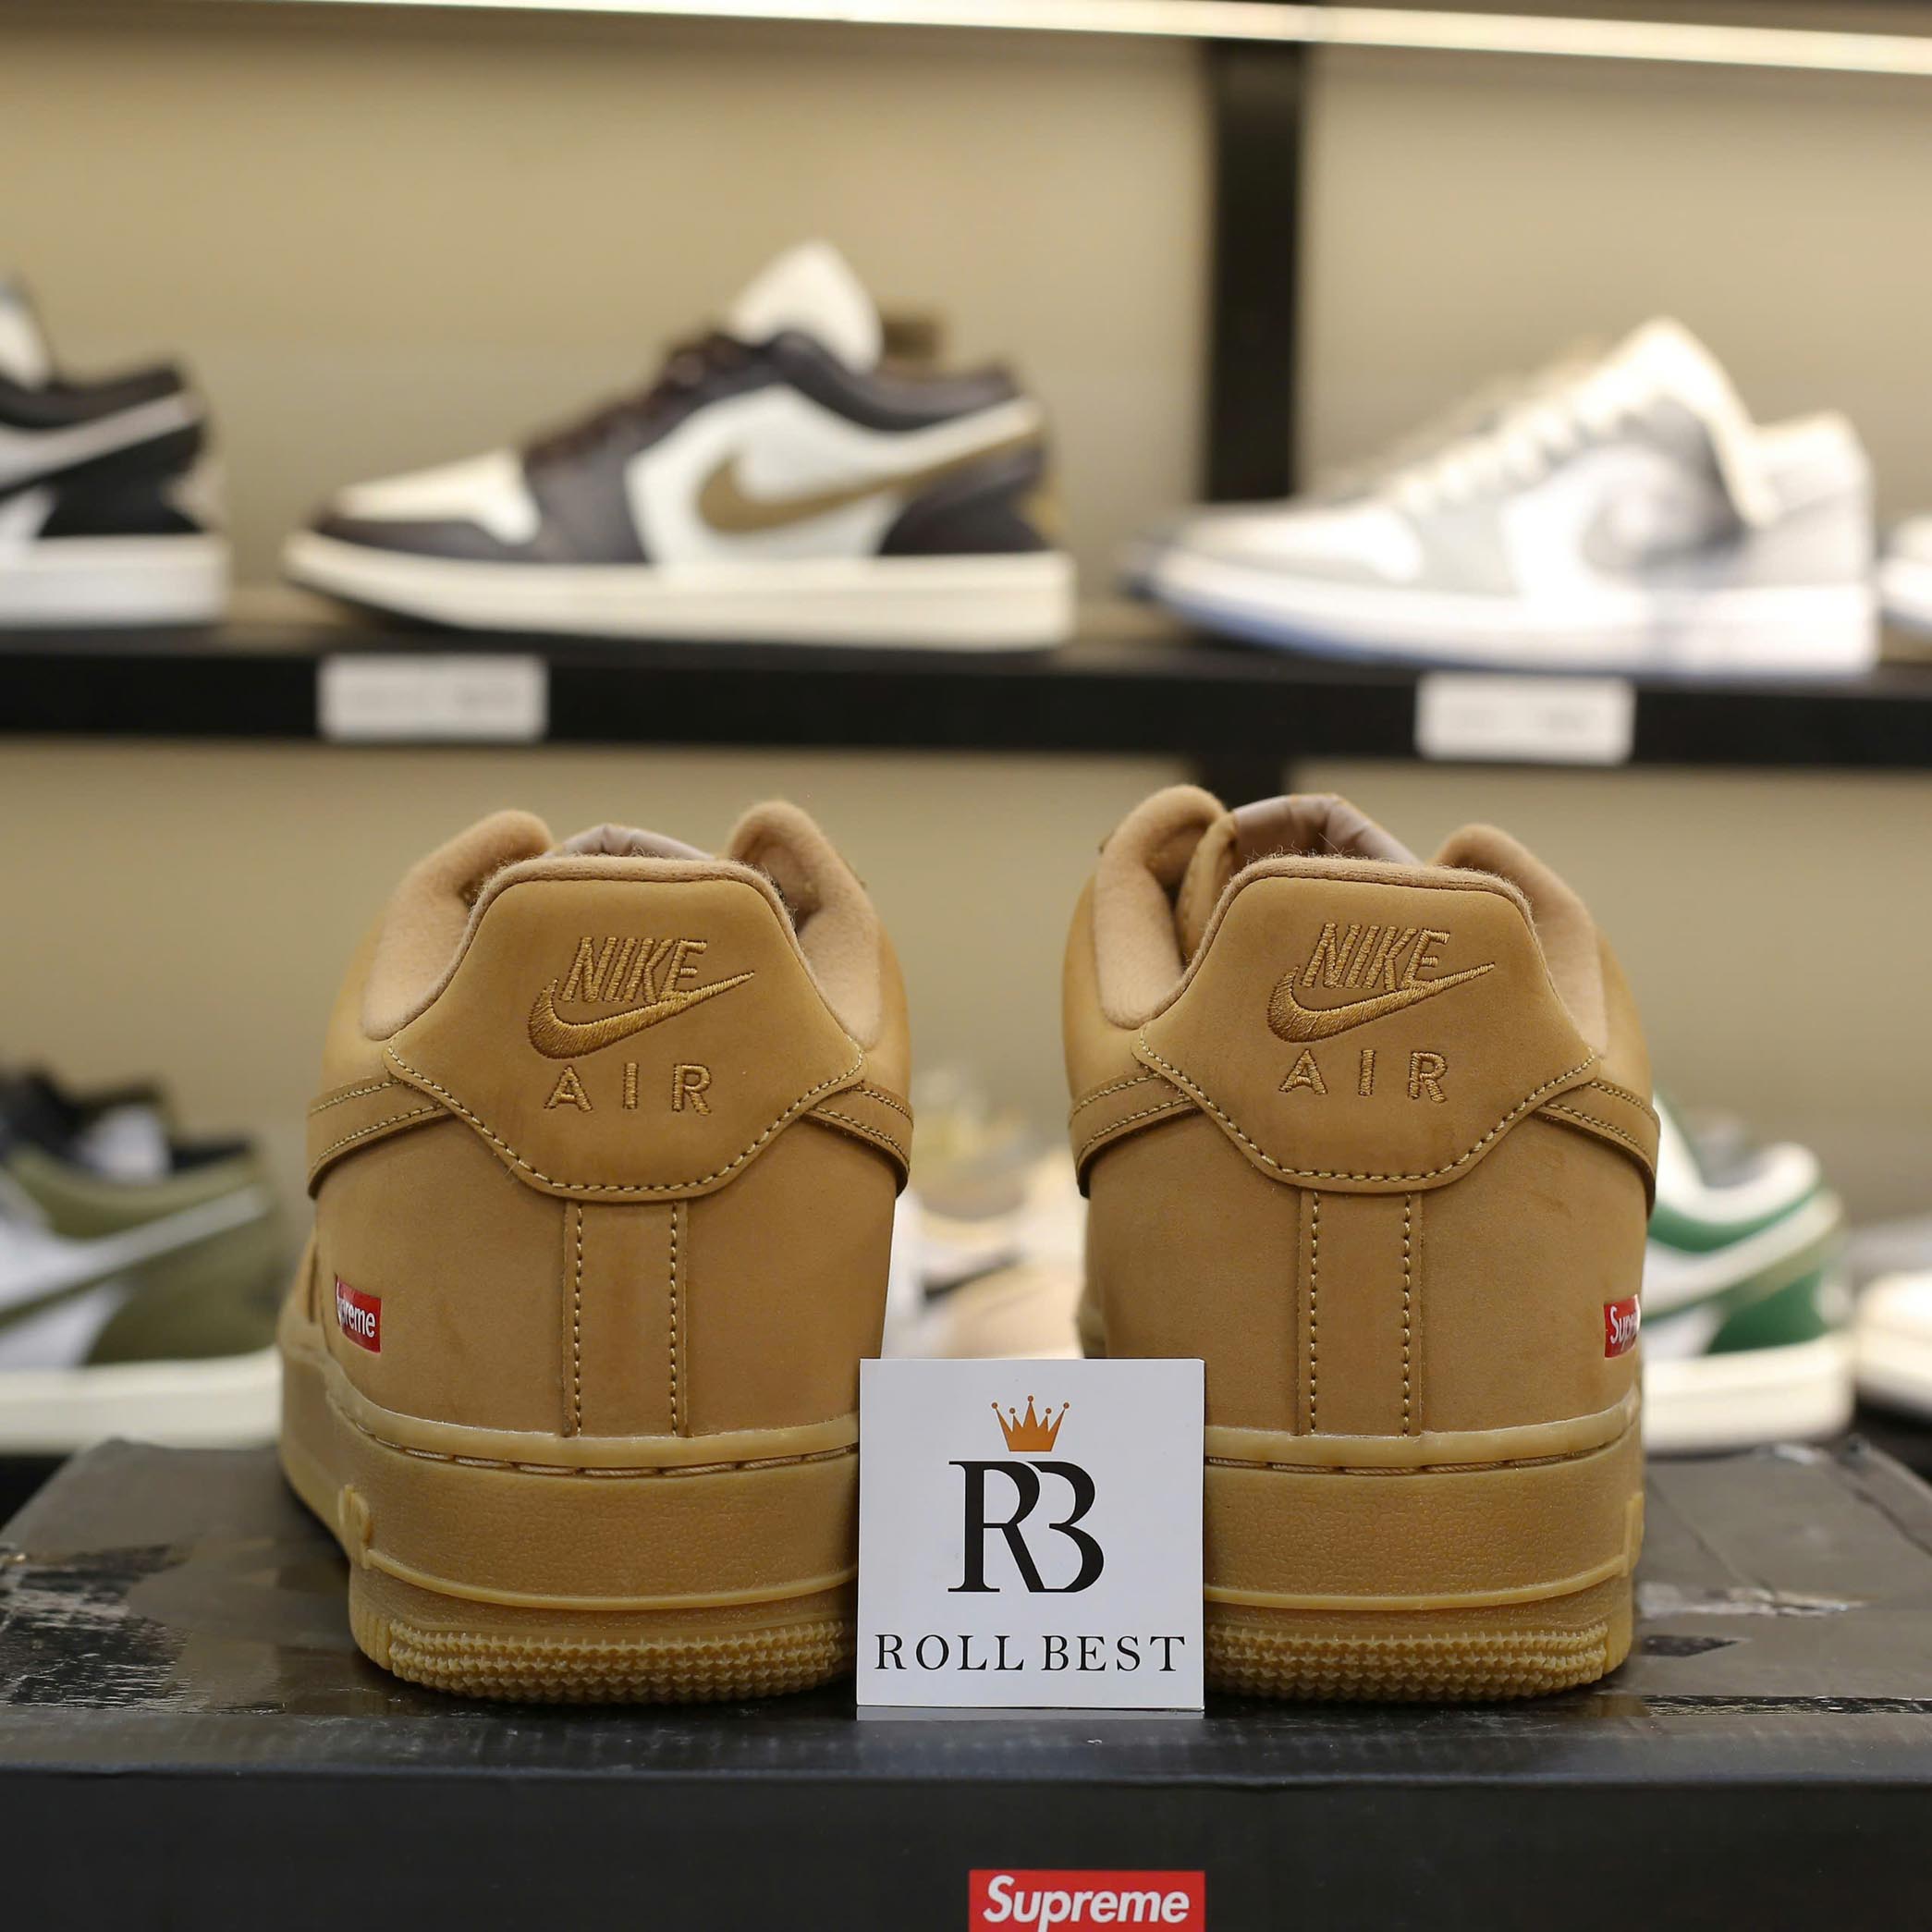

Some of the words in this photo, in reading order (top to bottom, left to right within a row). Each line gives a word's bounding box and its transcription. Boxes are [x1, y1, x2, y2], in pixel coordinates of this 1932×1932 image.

[558, 935, 708, 1004] NIKE
[1300, 923, 1450, 992] NIKE
[544, 1063, 713, 1116] AIR
[1278, 1048, 1449, 1104] AIR
[948, 1461, 1106, 1593] RB
[874, 1634, 1025, 1671] ROLL
[1041, 1635, 1186, 1672] BEST
[983, 1874, 1191, 1932] Supreme
